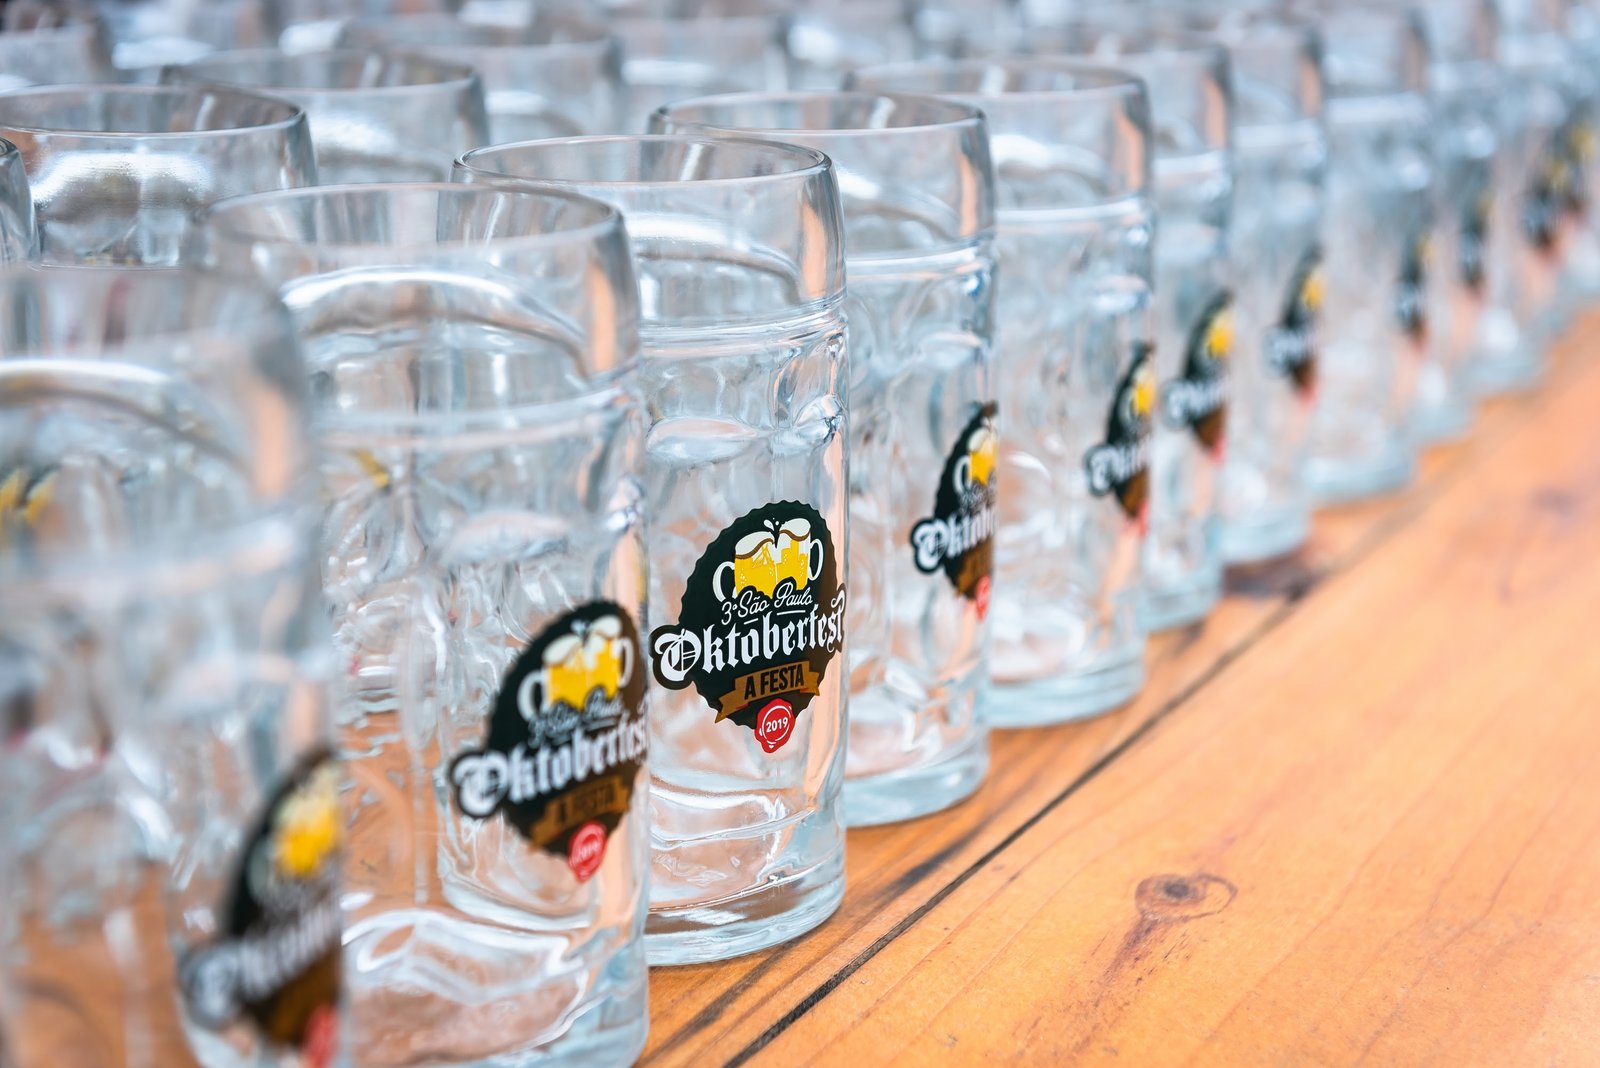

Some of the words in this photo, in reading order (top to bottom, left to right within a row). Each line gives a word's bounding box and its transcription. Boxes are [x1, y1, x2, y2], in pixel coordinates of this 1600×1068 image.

[738, 590, 769, 618] São
[774, 582, 813, 608] Paulo
[654, 589, 846, 682] Oktoberfest
[744, 677, 756, 700] A
[760, 664, 805, 696] FESTA
[766, 716, 788, 733] 2019
